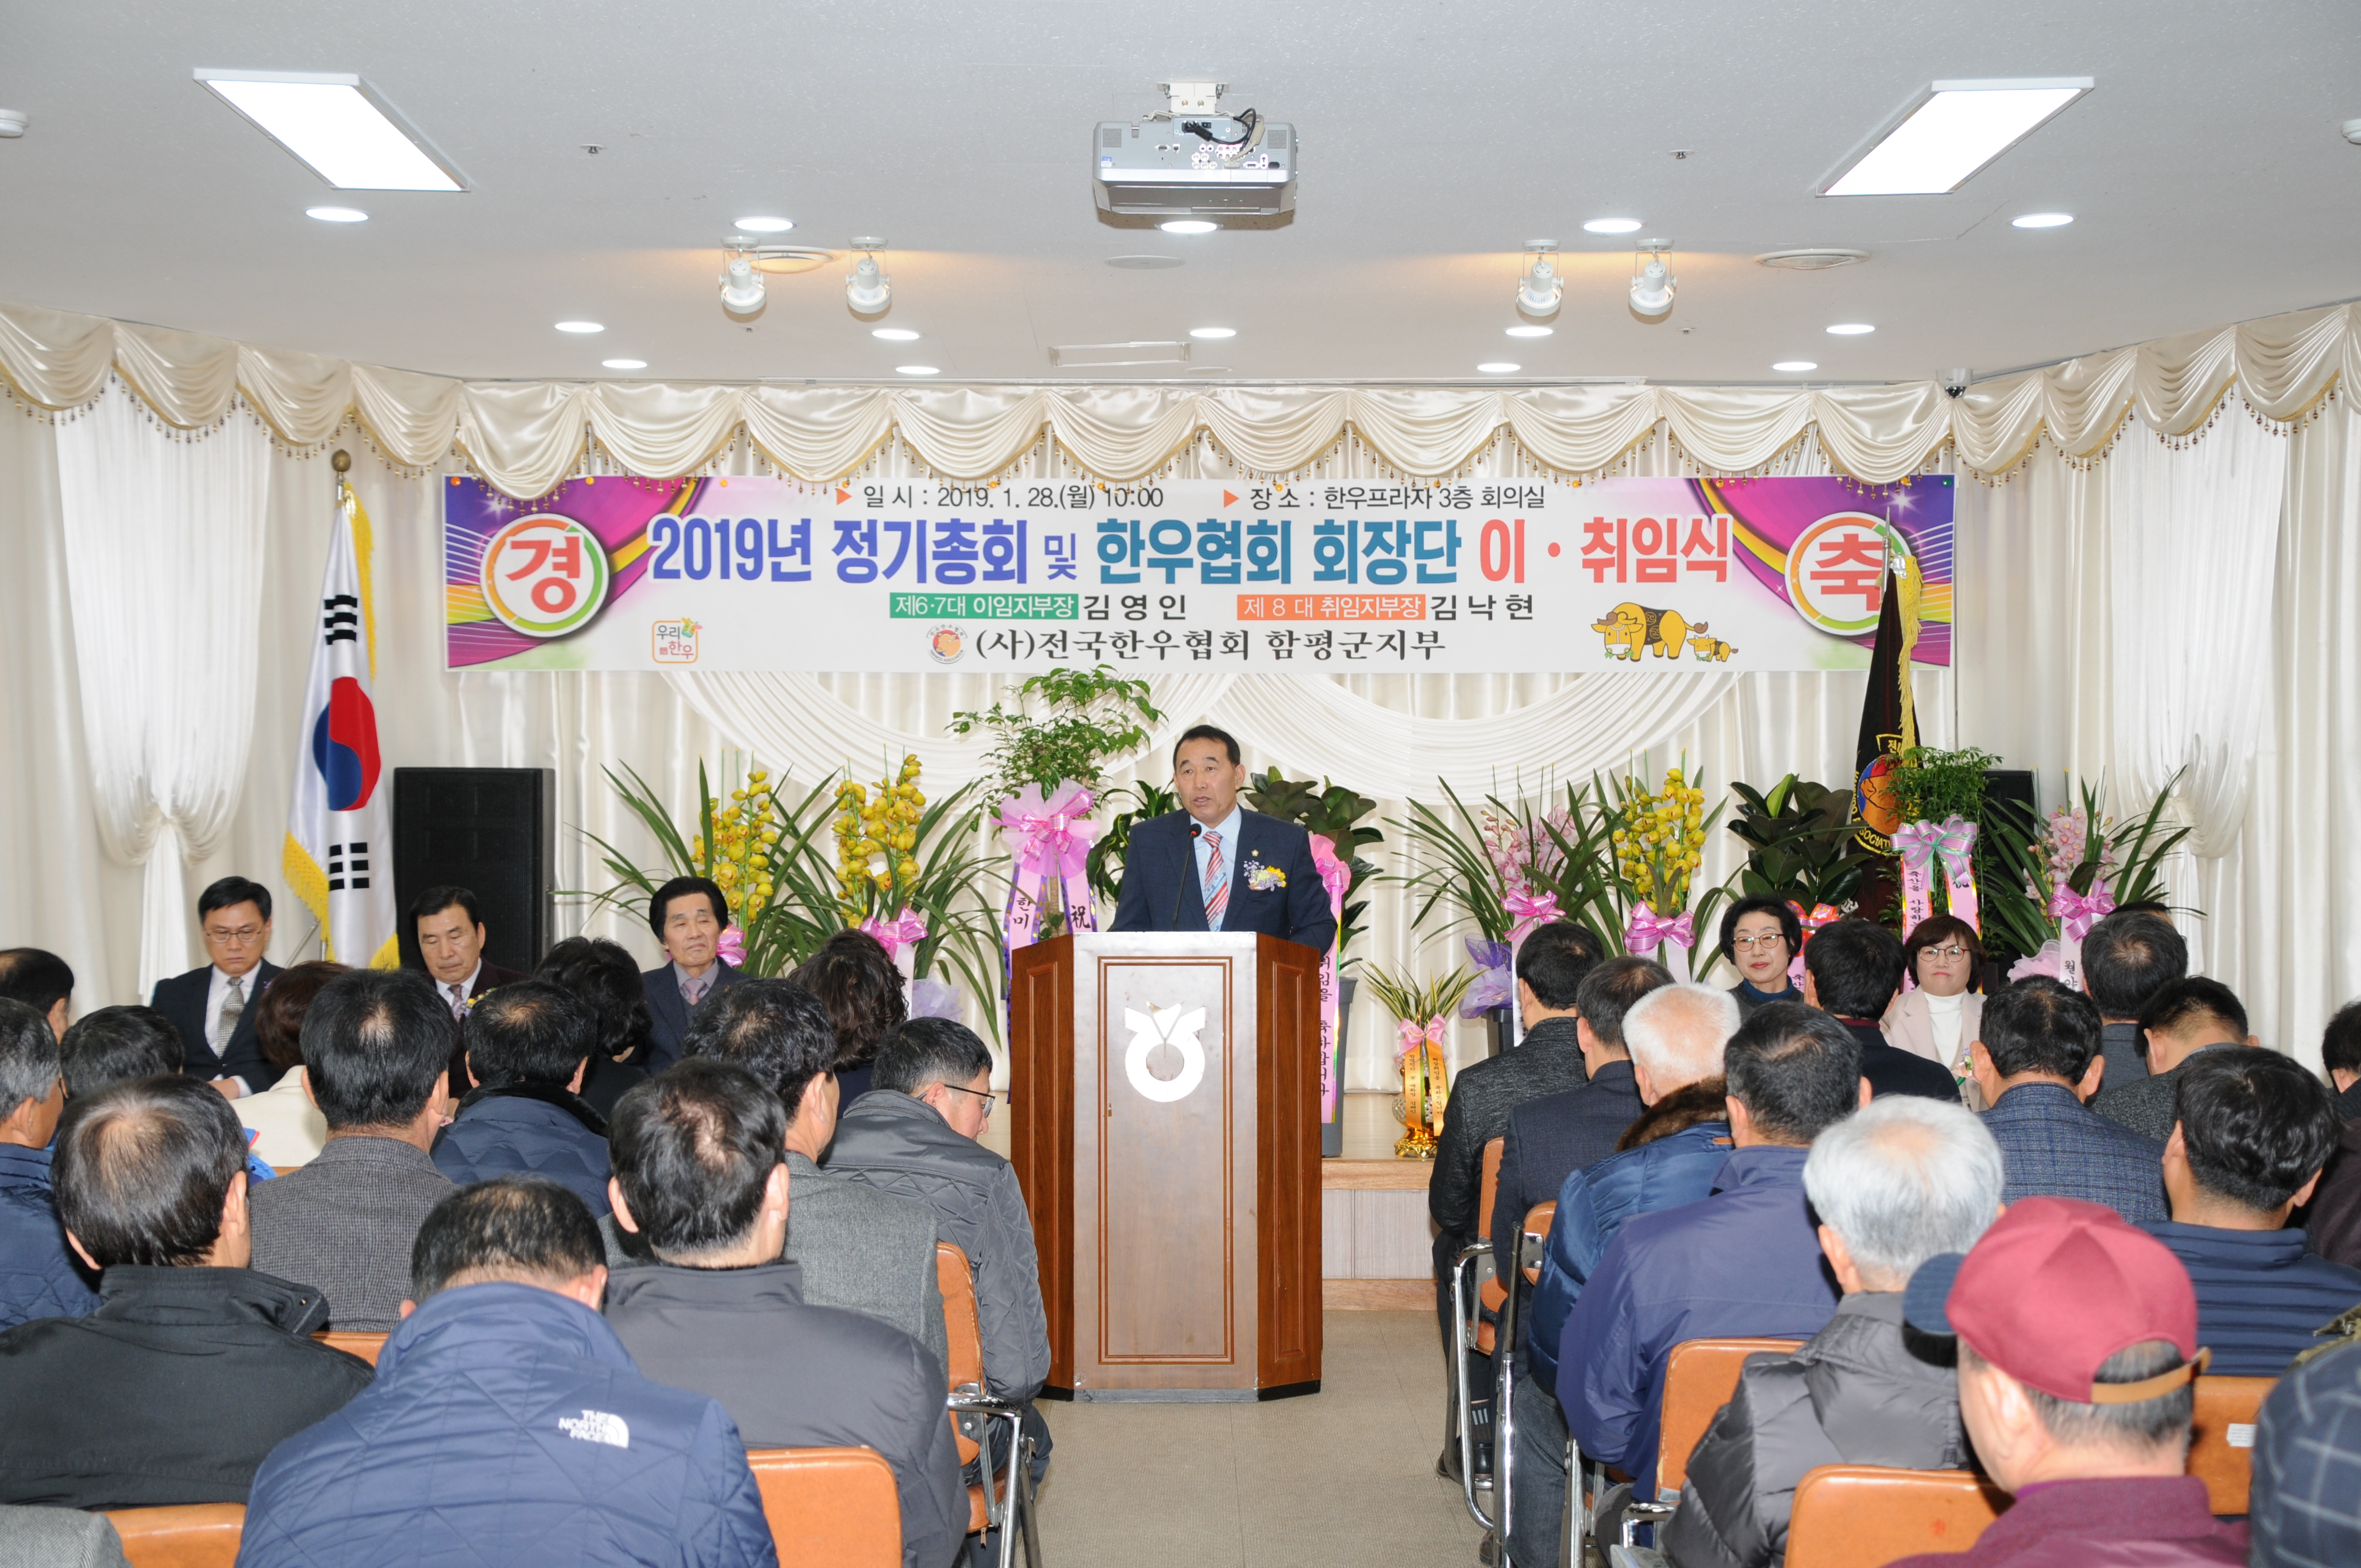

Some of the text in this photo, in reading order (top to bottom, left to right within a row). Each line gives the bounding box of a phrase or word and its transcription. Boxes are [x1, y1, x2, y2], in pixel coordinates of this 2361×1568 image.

[938, 487, 993, 508] 2019.
[1105, 487, 1163, 507] 10:00
[1324, 486, 1432, 510] 한우프라자
[1439, 487, 1473, 509] 3층
[1480, 485, 1545, 509] 회의실
[652, 518, 812, 582] 2019년
[832, 518, 1027, 585] 정기총회
[1044, 533, 1078, 580] 및
[1097, 518, 1291, 584] 한우협회
[1313, 519, 1462, 585] 회장단
[506, 539, 581, 614] 경
[1809, 533, 1883, 611] 축
[973, 596, 1074, 618] 이임지부장
[1320, 596, 1421, 618] 취임지부장
[656, 625, 680, 640] 우리
[668, 640, 694, 660] 한우
[976, 629, 1446, 661] (사)전국한우협회 함평군지부
[1070, 905, 1091, 929] 祝
[558, 1409, 608, 1442] THE NORTH FACE
